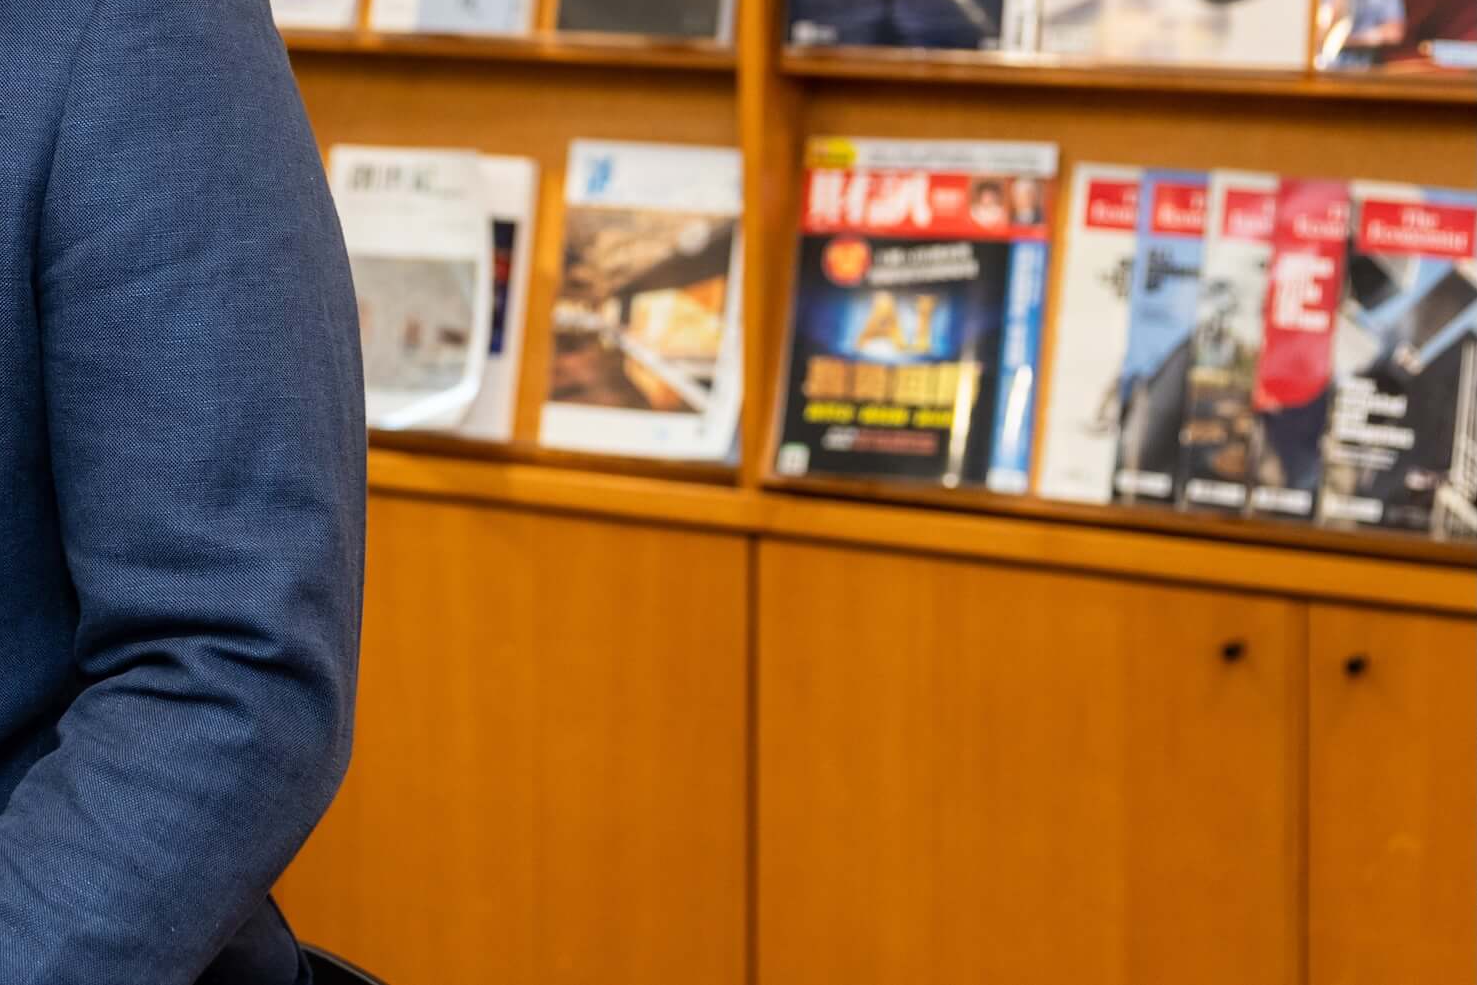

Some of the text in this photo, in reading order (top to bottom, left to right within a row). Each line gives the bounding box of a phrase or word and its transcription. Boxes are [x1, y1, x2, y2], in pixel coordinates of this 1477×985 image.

[1401, 206, 1440, 229] The
[1367, 218, 1469, 251] Economist
[855, 289, 940, 354] AI
